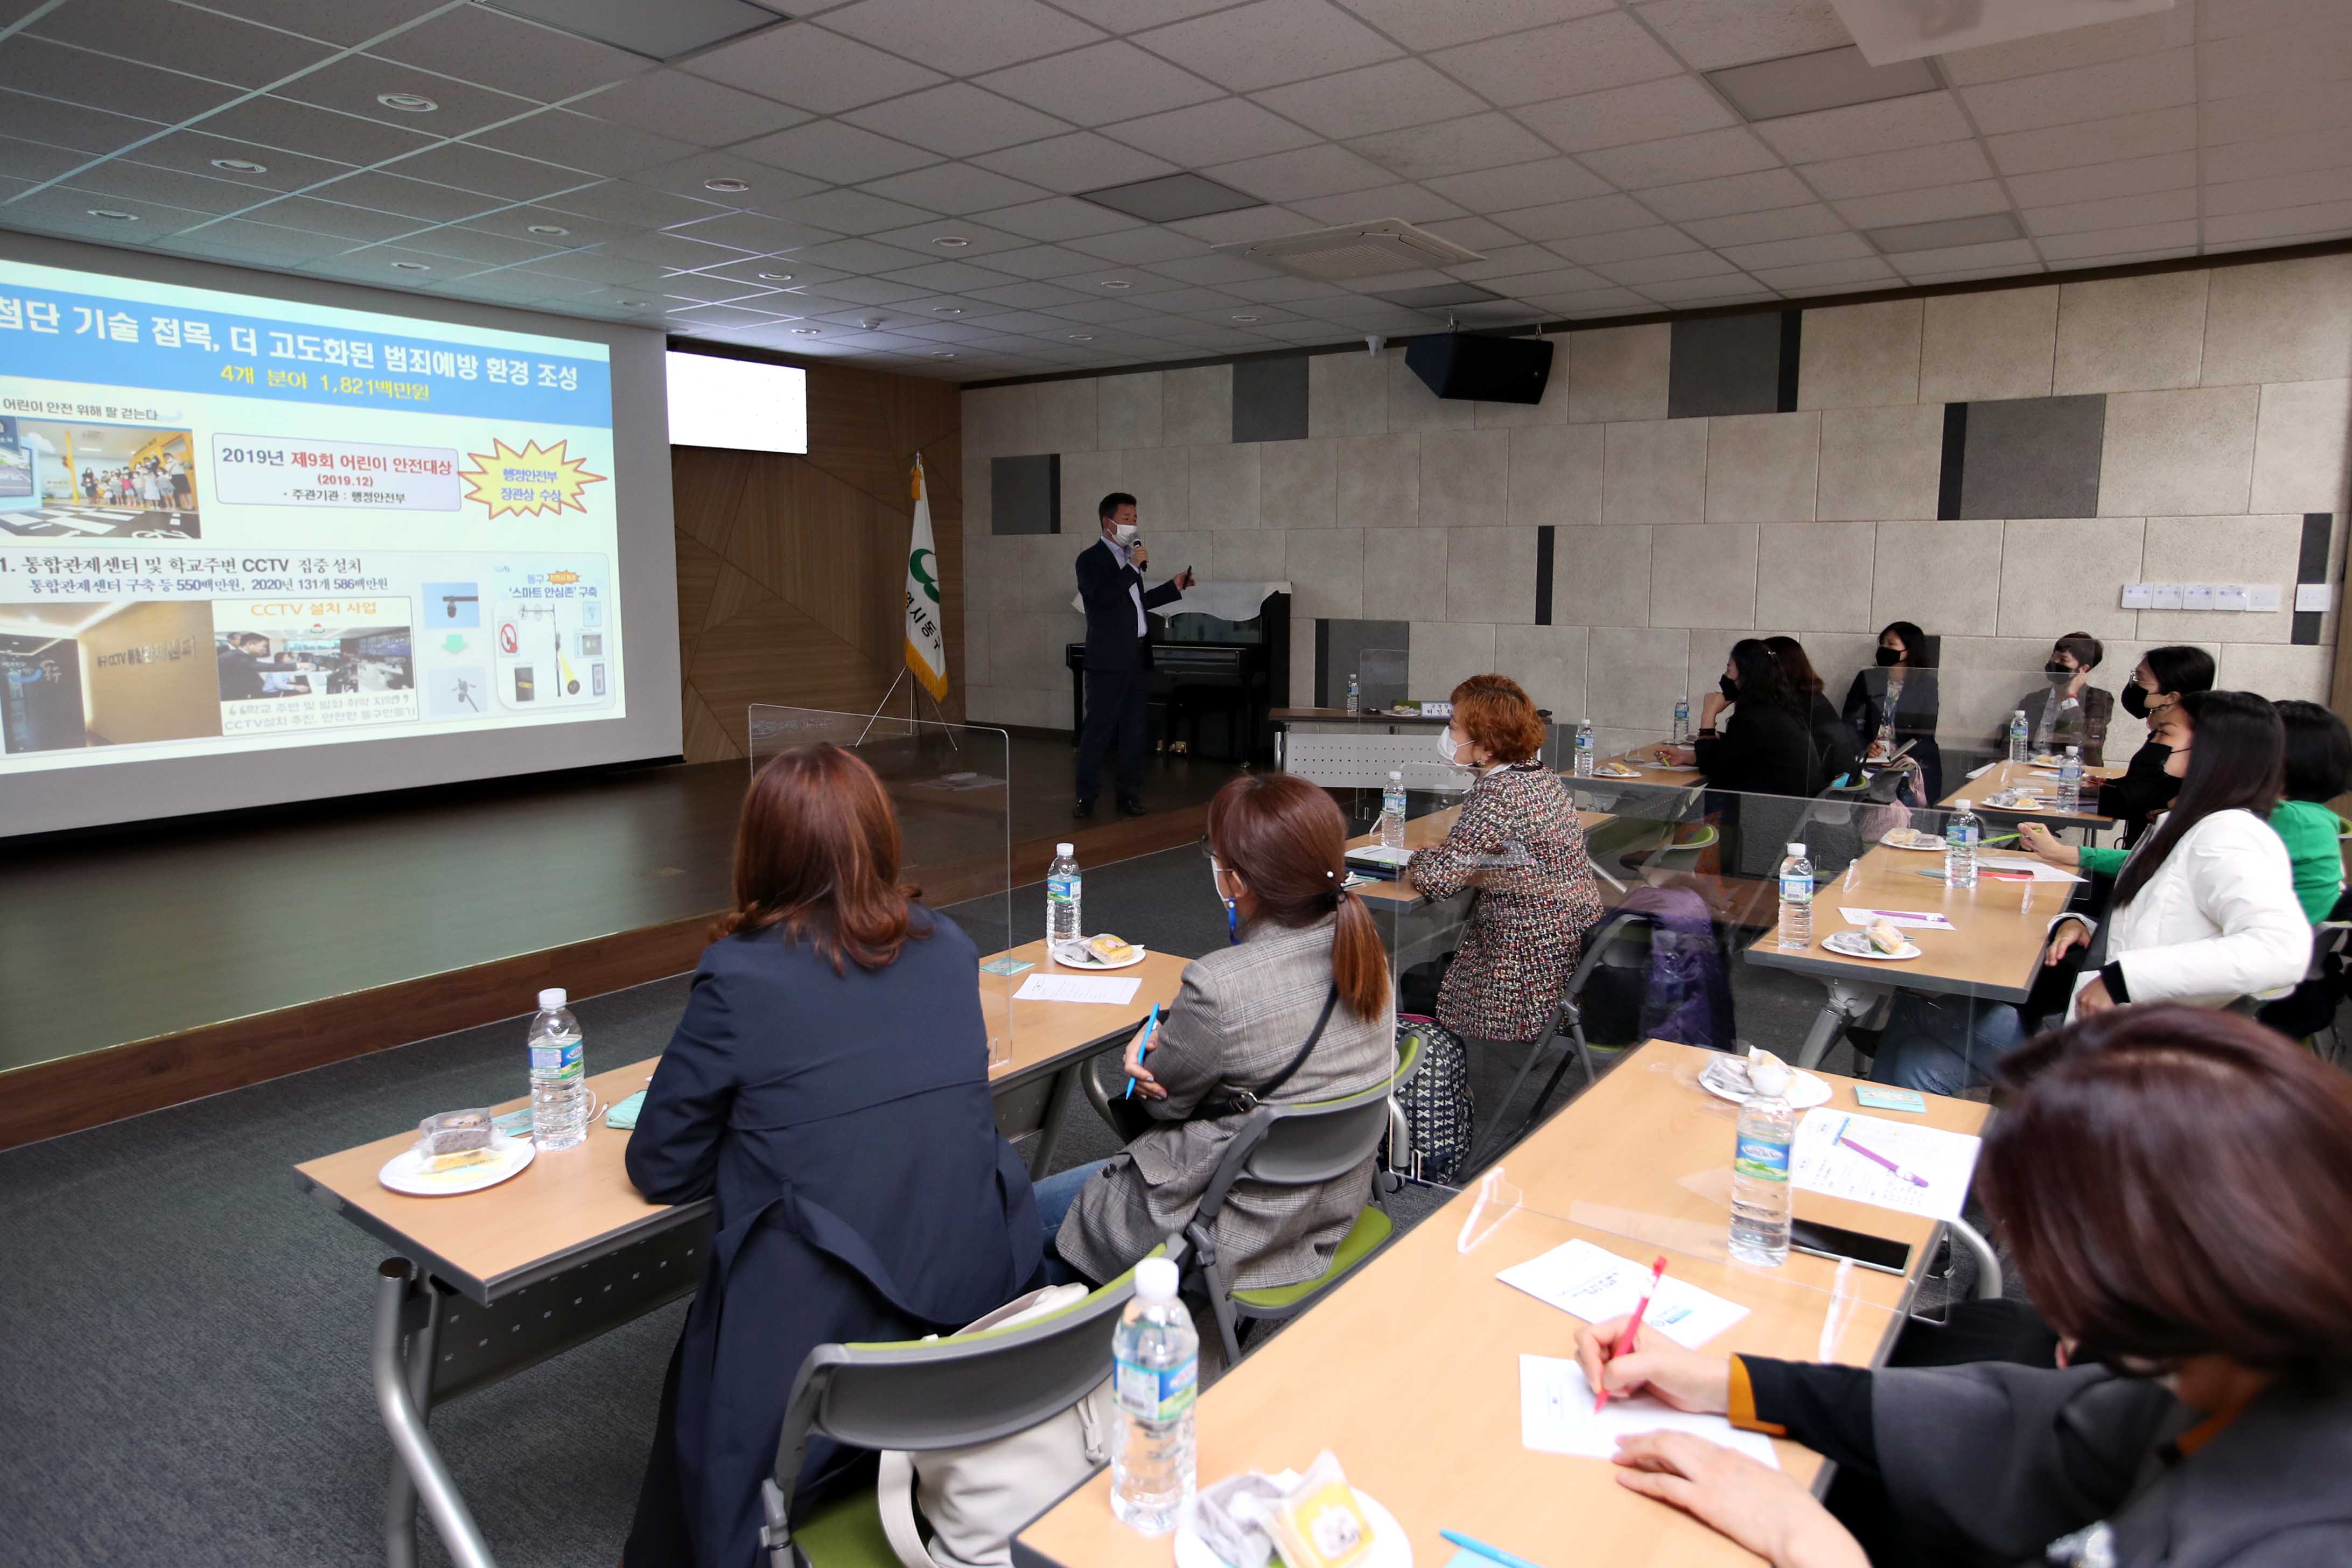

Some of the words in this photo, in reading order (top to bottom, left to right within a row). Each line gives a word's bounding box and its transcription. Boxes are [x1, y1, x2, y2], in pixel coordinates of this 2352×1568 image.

[0, 296, 60, 334] 첨단
[72, 306, 139, 344] 기술
[151, 316, 220, 353] 접목,
[230, 326, 258, 356] 더
[269, 332, 375, 369] 고도화된
[384, 344, 479, 381] 범죄예방
[486, 358, 530, 386] 환경
[537, 364, 578, 391] 조성
[220, 365, 254, 384] 4개
[267, 368, 308, 390] 분야
[321, 375, 430, 401] 1,821백만원
[3, 397, 44, 413] 어린이
[47, 402, 73, 415] 안전
[77, 404, 102, 417] 위해
[105, 407, 118, 418] 팔
[121, 408, 159, 421] 걷는다
[222, 447, 285, 467] 2019년
[291, 451, 334, 469] 제9회
[340, 454, 388, 472] 어린이
[393, 458, 452, 475] 안전대상
[317, 474, 374, 488] (2019.12)
[292, 489, 340, 502] 주관기관
[352, 491, 406, 505] 행정안전부
[539, 488, 562, 503] 수상
[22, 556, 139, 575] 통합관제센터
[145, 557, 162, 575] 및
[168, 557, 237, 575] 학교주변
[242, 558, 290, 573] CCTV
[298, 557, 330, 574] 집중
[332, 557, 362, 573] 설치
[28, 578, 121, 594] 통합관제센터
[125, 579, 156, 593] 구축
[159, 579, 173, 592] 등
[251, 578, 294, 592] 2020년
[298, 578, 331, 591] 131개
[333, 577, 389, 591] 586백만원
[250, 603, 304, 616] CCTV
[310, 603, 341, 615] 설치
[346, 601, 377, 614] 사업
[108, 652, 127, 667] CCTV
